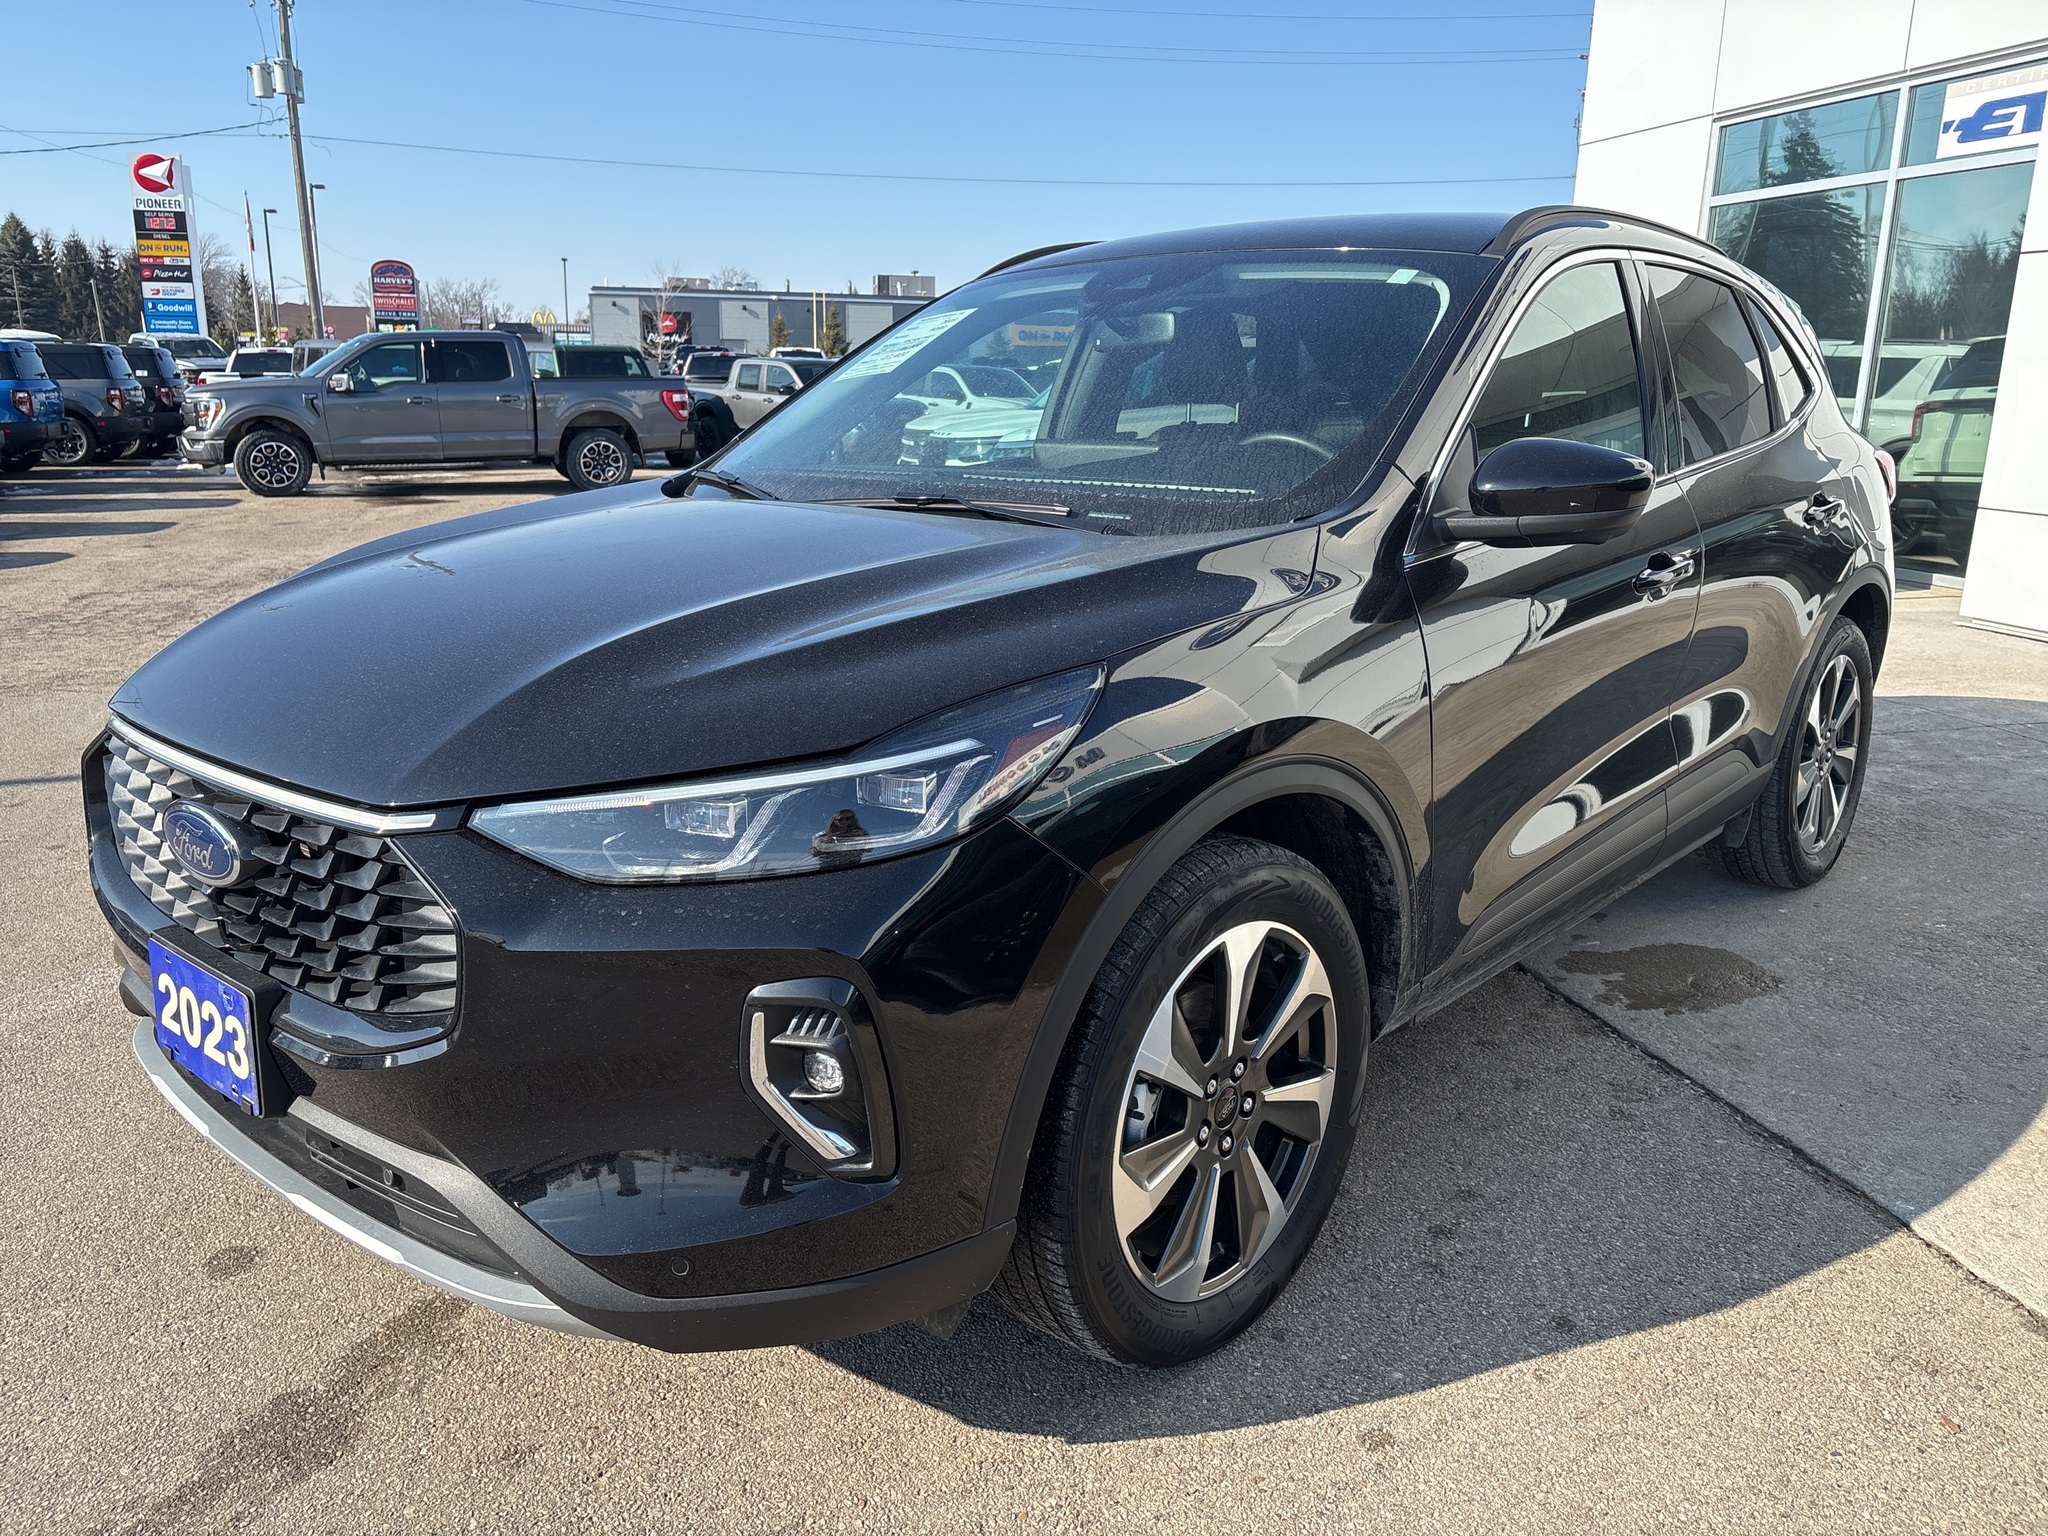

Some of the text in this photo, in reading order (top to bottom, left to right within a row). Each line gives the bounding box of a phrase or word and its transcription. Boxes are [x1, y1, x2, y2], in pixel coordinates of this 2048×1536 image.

[135, 198, 181, 209] PIONEER
[153, 269, 172, 277] Pizza
[374, 277, 413, 285] HARVEY'S
[157, 303, 193, 312] Goodwill
[173, 820, 214, 870] Ford
[157, 972, 250, 1080] 2023
